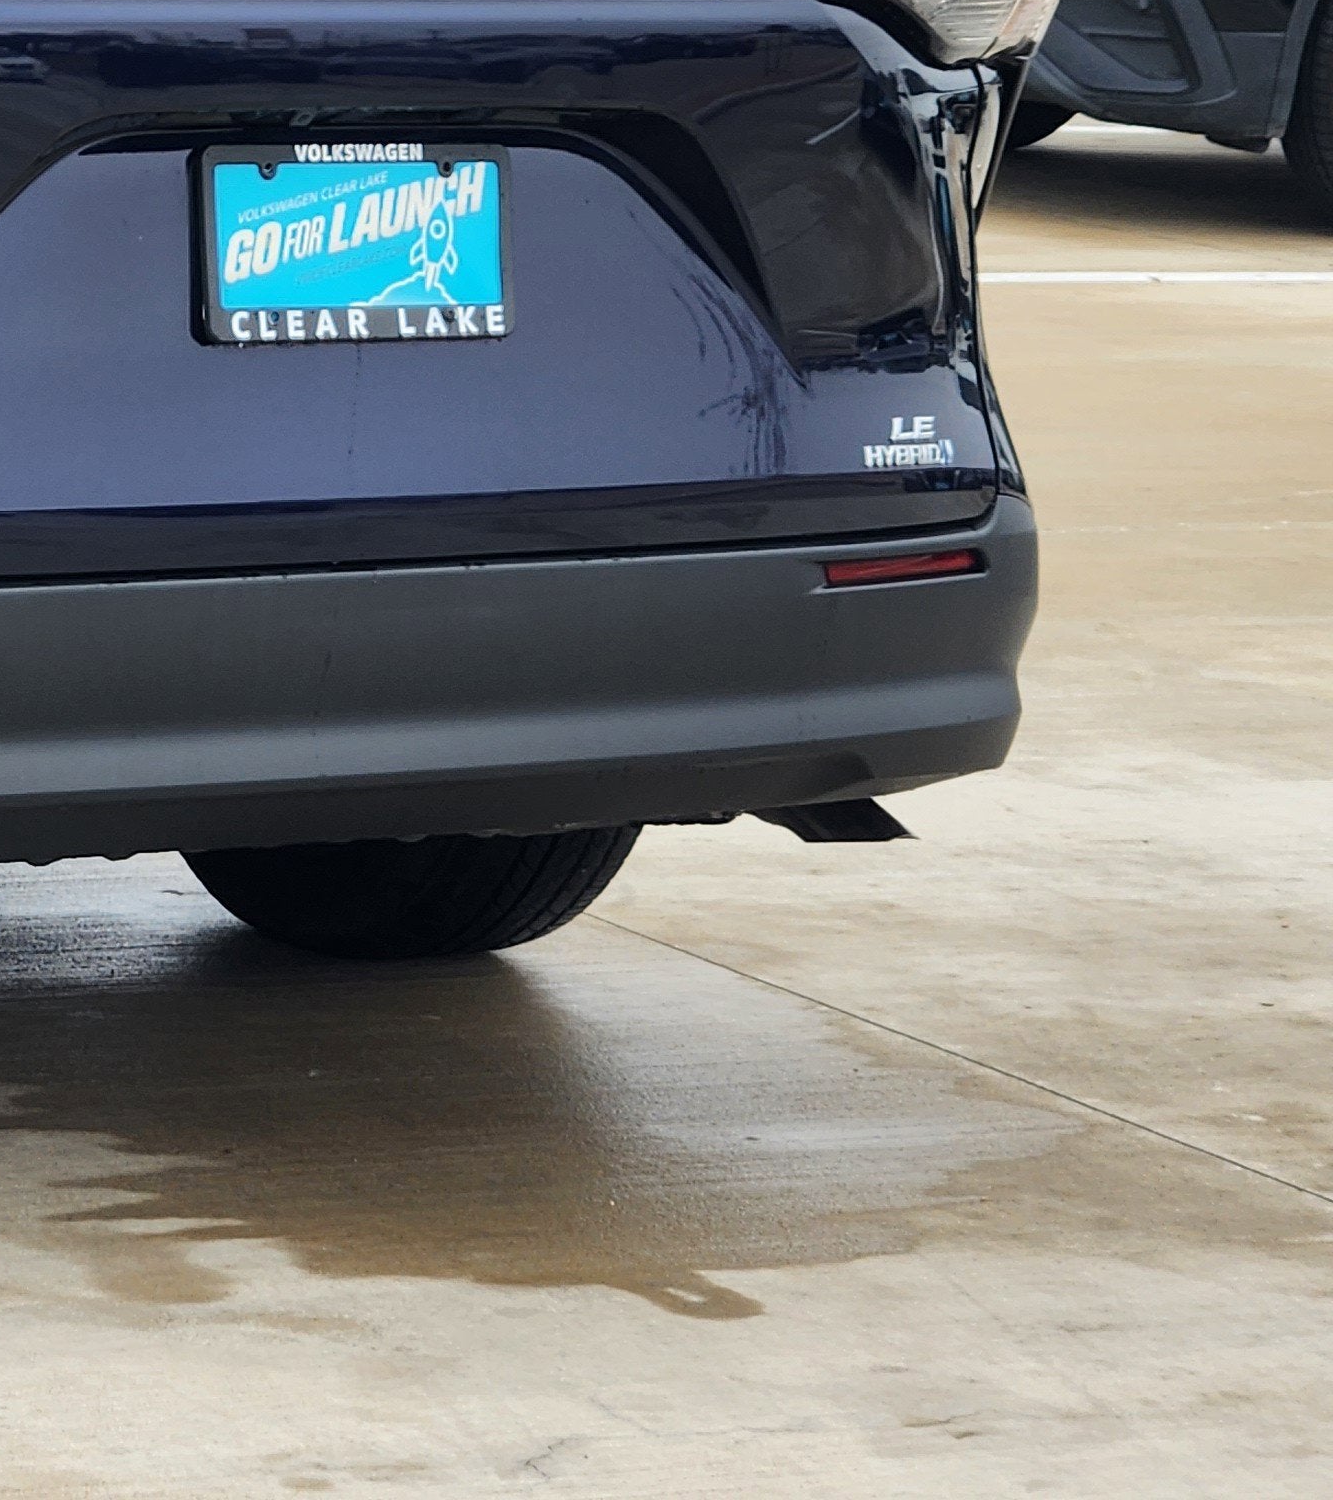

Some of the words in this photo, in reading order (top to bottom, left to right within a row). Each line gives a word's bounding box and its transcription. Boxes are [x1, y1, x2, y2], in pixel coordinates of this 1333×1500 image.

[293, 143, 425, 163] VOLKSWAGEN
[237, 191, 319, 225] VOLKSWAGEN
[320, 179, 358, 201] CLEAR
[359, 170, 389, 191] LAKE
[224, 220, 283, 284] GO
[281, 215, 327, 265] FOR
[327, 161, 487, 255] LAUNCH
[230, 308, 371, 341] CLEAR
[397, 304, 507, 338] LAKE
[889, 416, 936, 441] LE
[862, 442, 943, 468] HYBRID
